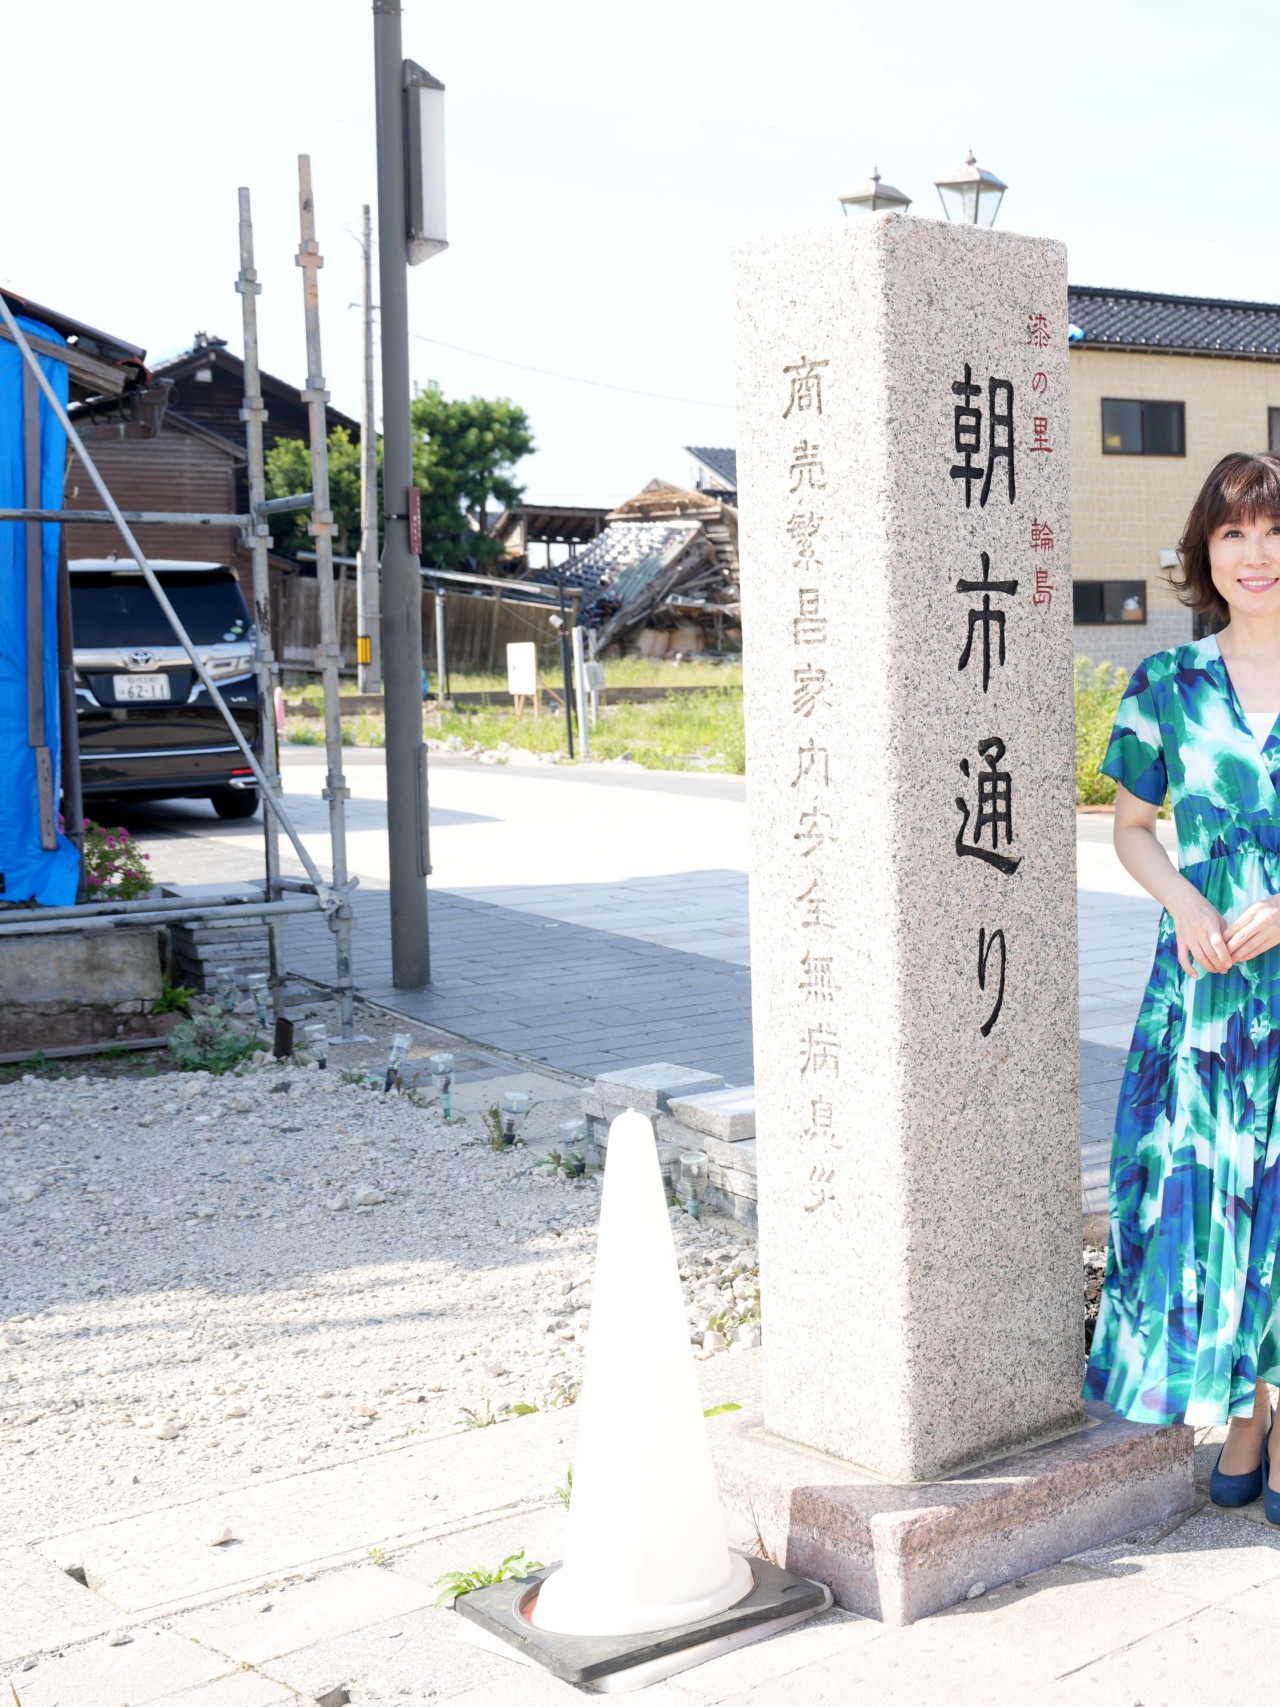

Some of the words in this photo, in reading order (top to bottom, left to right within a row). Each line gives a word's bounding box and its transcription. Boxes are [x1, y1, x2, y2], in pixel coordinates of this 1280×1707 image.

[1026, 313, 1053, 453] 漆の里
[1030, 517, 1054, 606] 輪島
[127, 685, 165, 699] 62-11
[949, 362, 1021, 1037] 朝市通り
